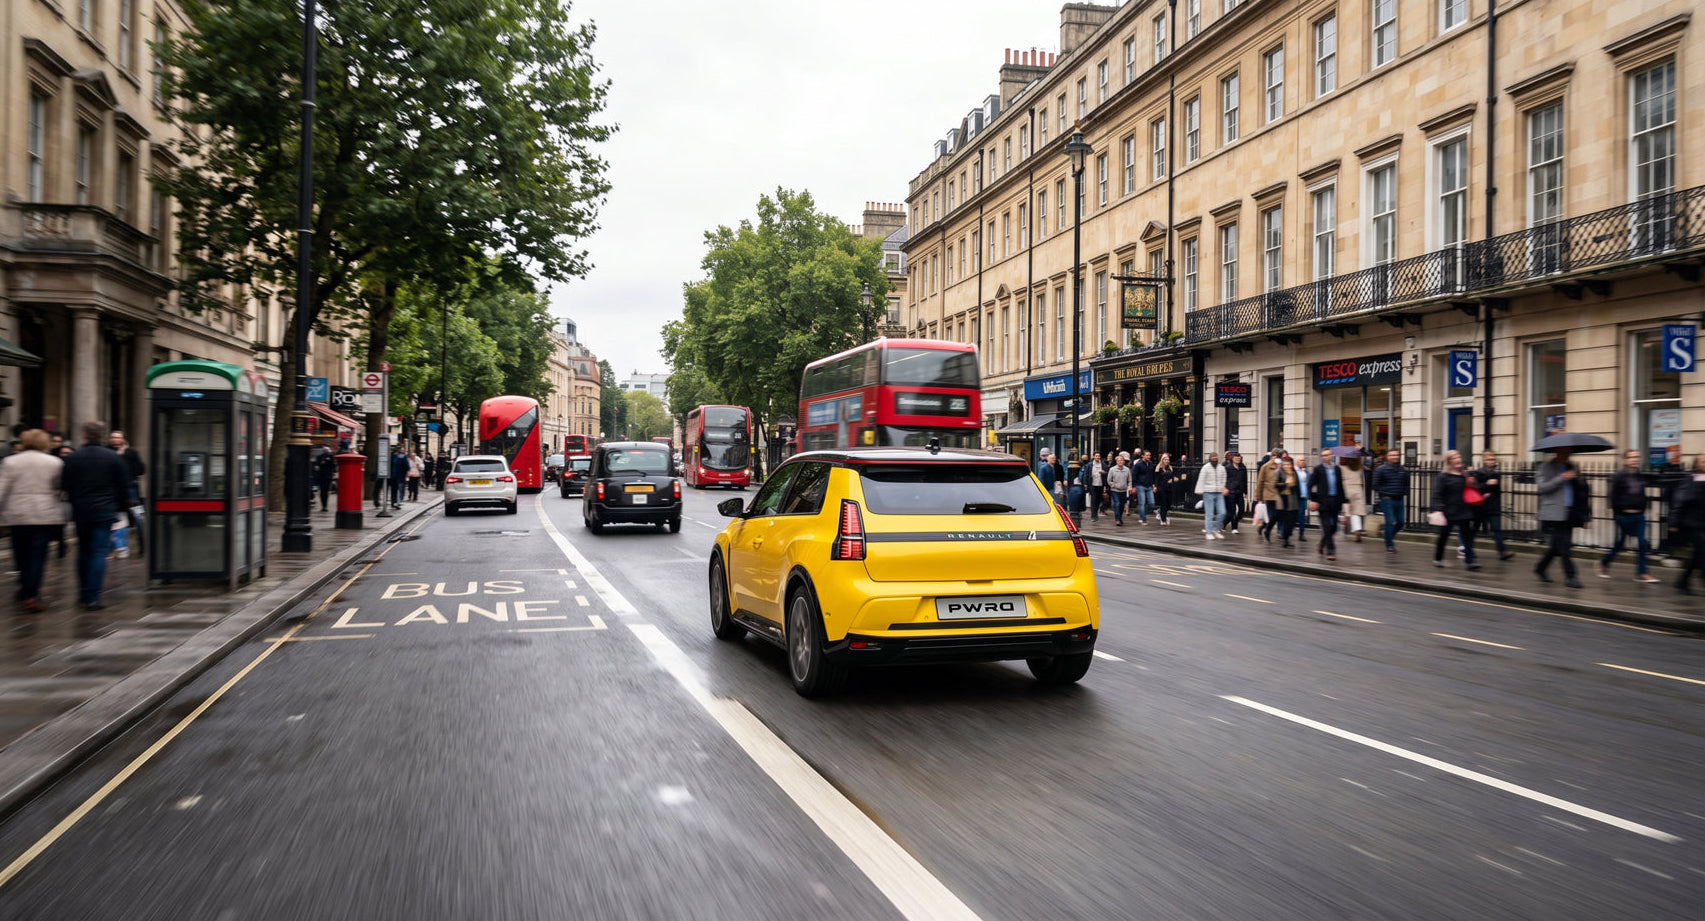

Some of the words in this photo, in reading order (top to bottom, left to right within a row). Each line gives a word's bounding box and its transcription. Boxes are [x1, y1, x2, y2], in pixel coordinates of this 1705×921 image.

[1669, 337, 1692, 370] S
[1114, 370, 1126, 380] THE
[1318, 362, 1357, 379] TESCO
[1358, 360, 1401, 378] express
[1455, 360, 1473, 386] S
[1219, 397, 1248, 405] express
[380, 580, 525, 600] BUS
[330, 601, 568, 630] LANE
